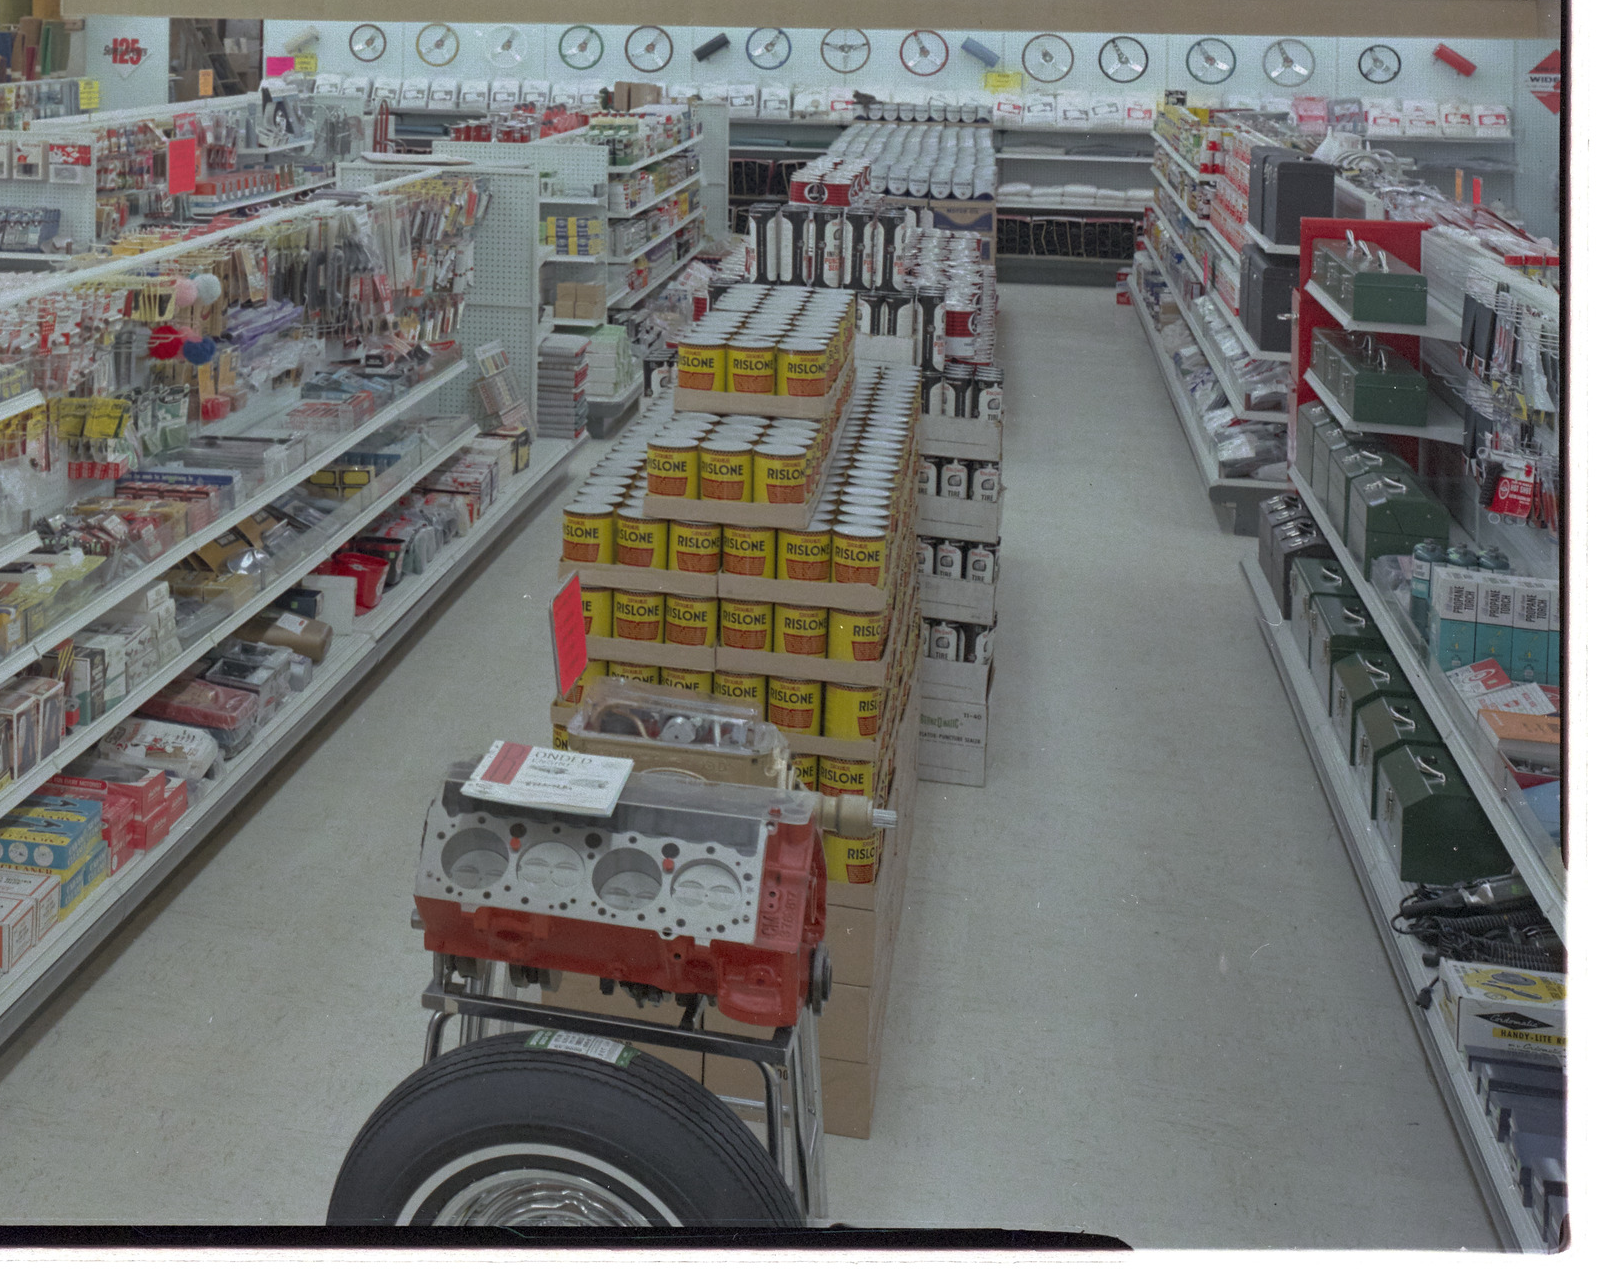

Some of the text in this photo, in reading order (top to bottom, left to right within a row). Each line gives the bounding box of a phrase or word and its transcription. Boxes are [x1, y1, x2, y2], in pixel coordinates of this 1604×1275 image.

[112, 38, 142, 65] 125
[835, 546, 880, 562] RISLONE
[616, 601, 660, 617] RISLONE
[1453, 586, 1465, 614] PROPANE
[1464, 590, 1475, 611] TORCH
[1489, 589, 1501, 618] PROPANE
[1500, 594, 1511, 615] TORCH
[1526, 593, 1537, 622] PROPANE
[1537, 599, 1548, 620] TORCH
[723, 610, 767, 626] RISLONE
[770, 686, 813, 704] RISLONE
[1501, 1029, 1551, 1043] HANDY-LITE
